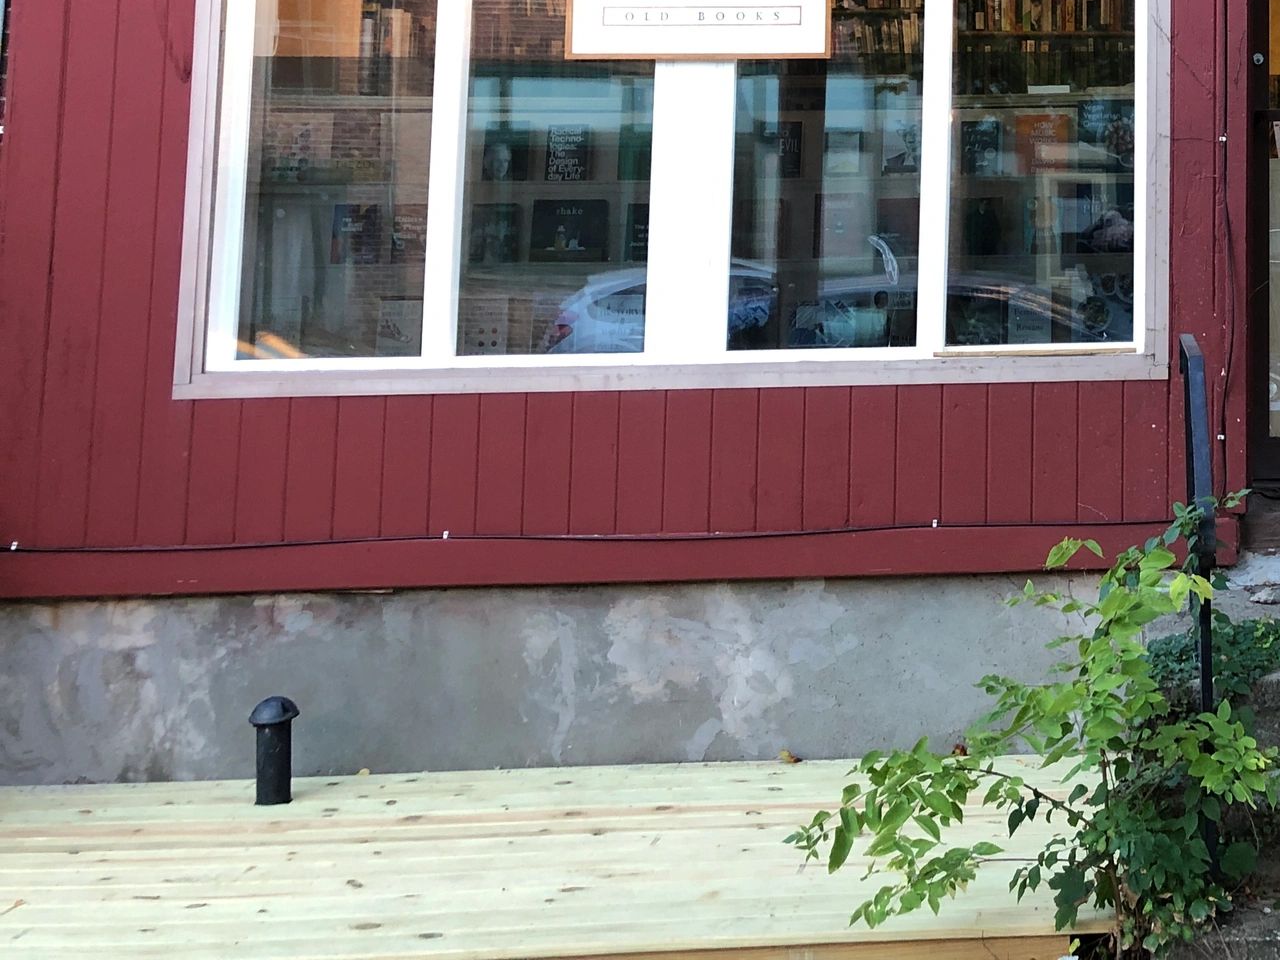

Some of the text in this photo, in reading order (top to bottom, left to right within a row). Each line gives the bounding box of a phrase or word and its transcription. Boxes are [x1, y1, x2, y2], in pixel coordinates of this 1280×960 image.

[625, 11, 780, 21] OLD BOOKS
[549, 157, 579, 166] Design
